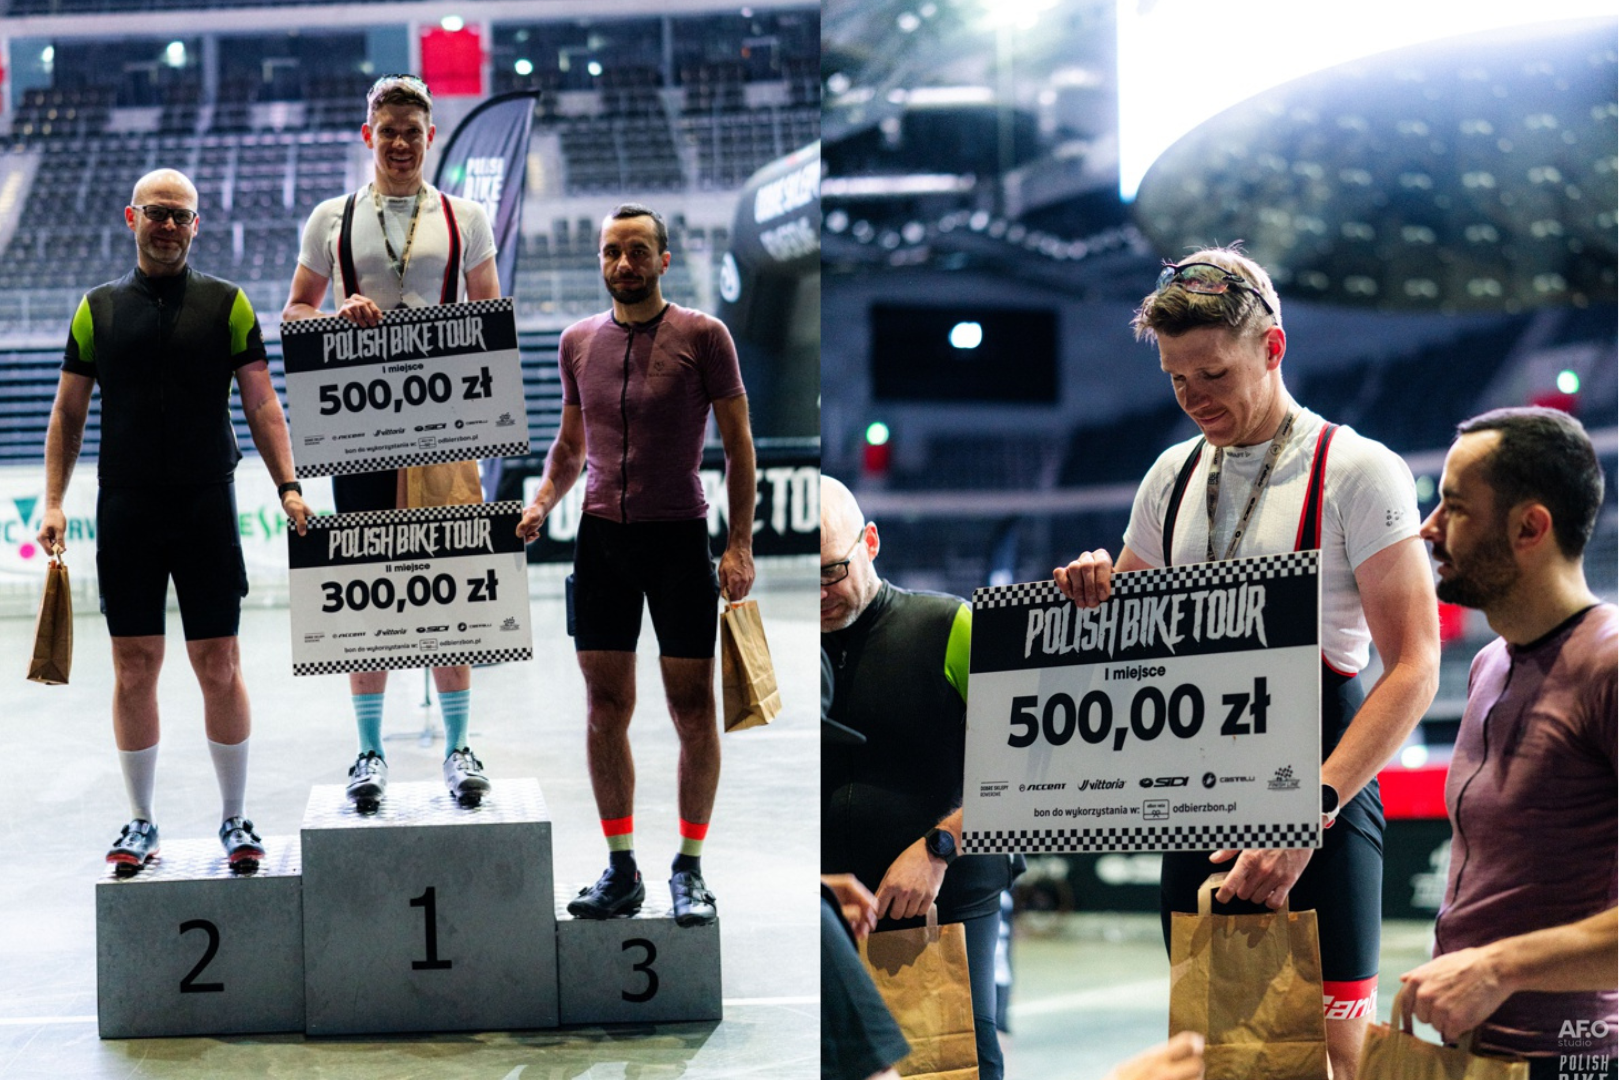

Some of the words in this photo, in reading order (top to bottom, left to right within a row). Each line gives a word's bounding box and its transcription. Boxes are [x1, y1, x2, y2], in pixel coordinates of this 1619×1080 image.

[323, 325, 387, 363] POLISH
[390, 323, 434, 357] BIKE
[434, 314, 487, 351] TOUR
[320, 372, 452, 416] 500,00
[462, 366, 492, 400] zł
[388, 363, 424, 374] miejsce
[329, 525, 392, 560] POLISH
[396, 522, 440, 557] BIKE
[442, 517, 494, 554] TOUR
[321, 574, 456, 613] 300,00
[467, 569, 498, 602] zł
[394, 562, 430, 573] miejsce
[1024, 598, 1118, 659] POLISH
[1120, 593, 1188, 654] BIKE
[1190, 582, 1268, 648] TOUR
[1104, 668, 1109, 680] I
[1113, 664, 1166, 681] miejsce
[1007, 684, 1205, 750] 500,00
[1220, 676, 1270, 736] zł
[1034, 808, 1050, 817] bon
[1052, 808, 1063, 816] do
[1065, 805, 1128, 818] wykorzystania
[1130, 806, 1140, 814] w:
[1173, 802, 1236, 814] odbierzbon.pl
[409, 886, 452, 970] 1
[178, 919, 225, 994] 2
[620, 938, 660, 1002] 3
